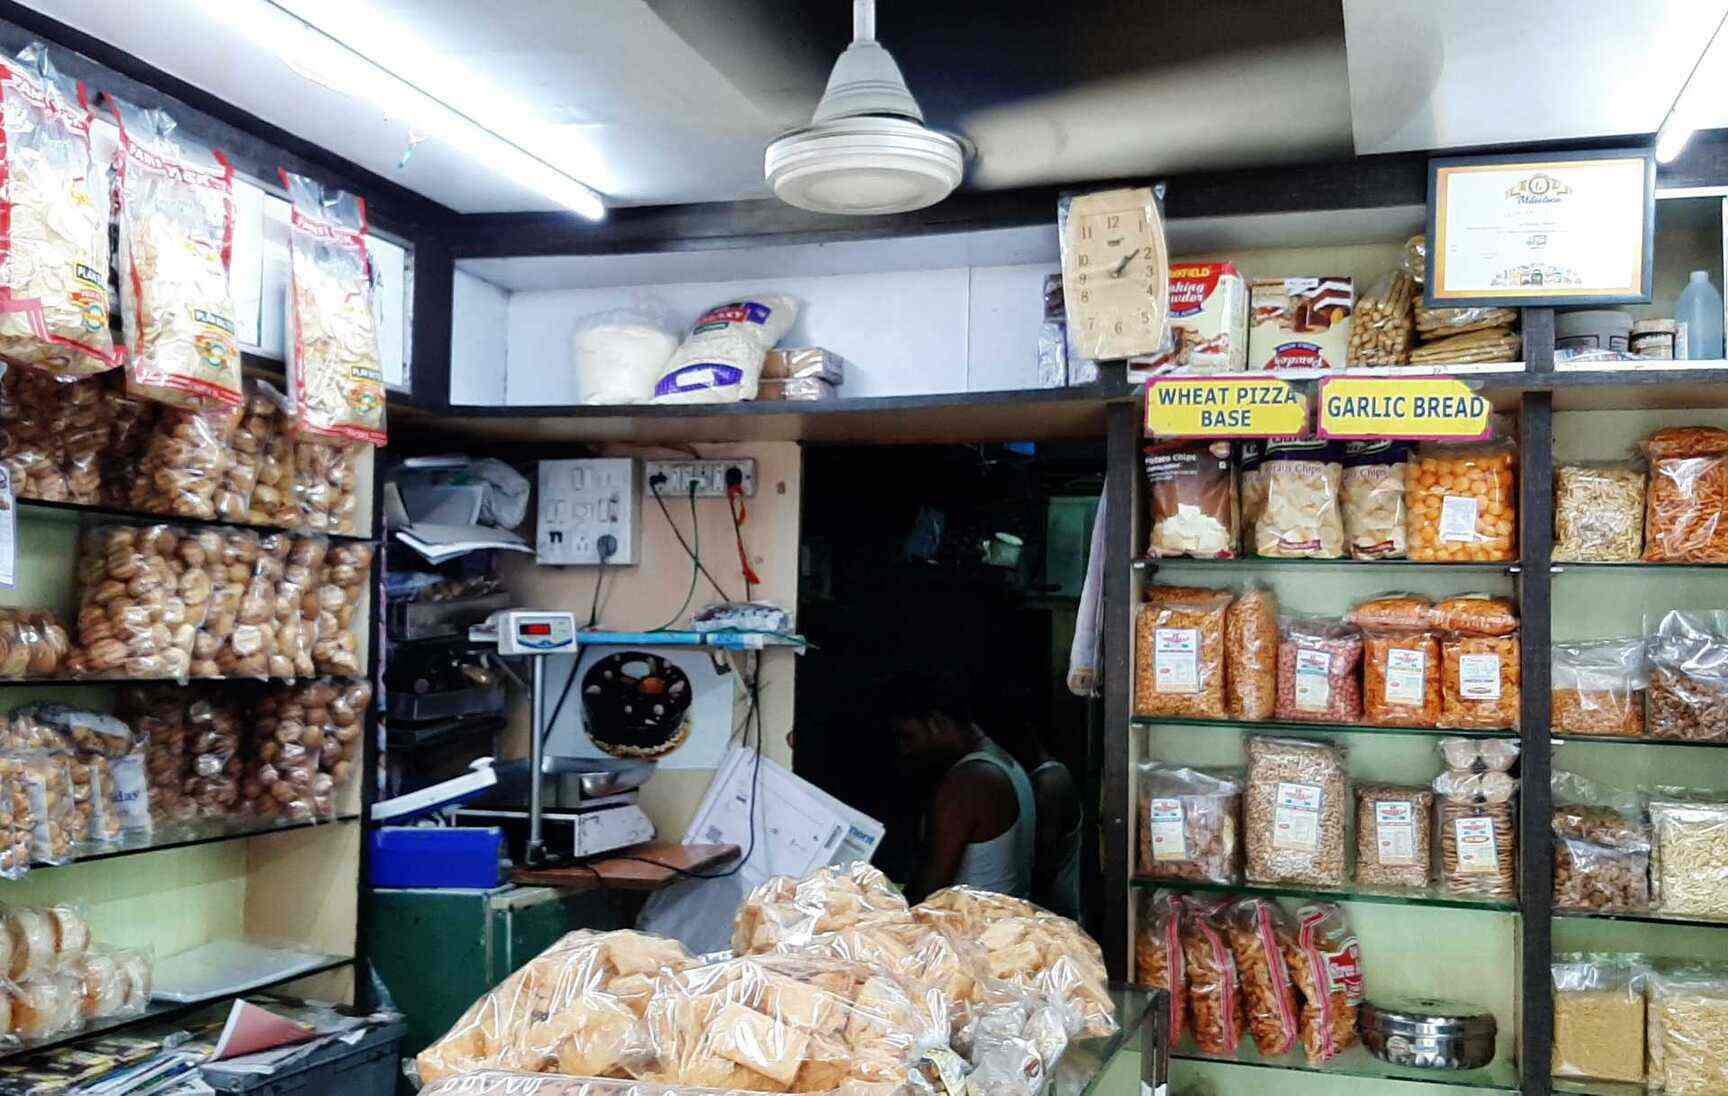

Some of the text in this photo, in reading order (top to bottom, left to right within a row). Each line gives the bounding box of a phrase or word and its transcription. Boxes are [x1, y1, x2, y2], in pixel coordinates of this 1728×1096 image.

[1107, 216, 1120, 229] 12
[1138, 220, 1144, 232] 1
[1081, 227, 1093, 239] 11
[1144, 247, 1153, 260] 2
[1078, 254, 1089, 267] 10
[1145, 265, 1154, 278] 3
[1079, 274, 1087, 286] 9
[1146, 284, 1154, 296] 4
[1081, 291, 1089, 303] 8
[1088, 317, 1096, 331] 7
[1141, 311, 1150, 325] 5
[1114, 321, 1123, 335] 6
[1158, 387, 1298, 405] WHEAT PIZZA
[1328, 396, 1484, 418] GARLIC BREAD
[1201, 410, 1251, 427] BASE
